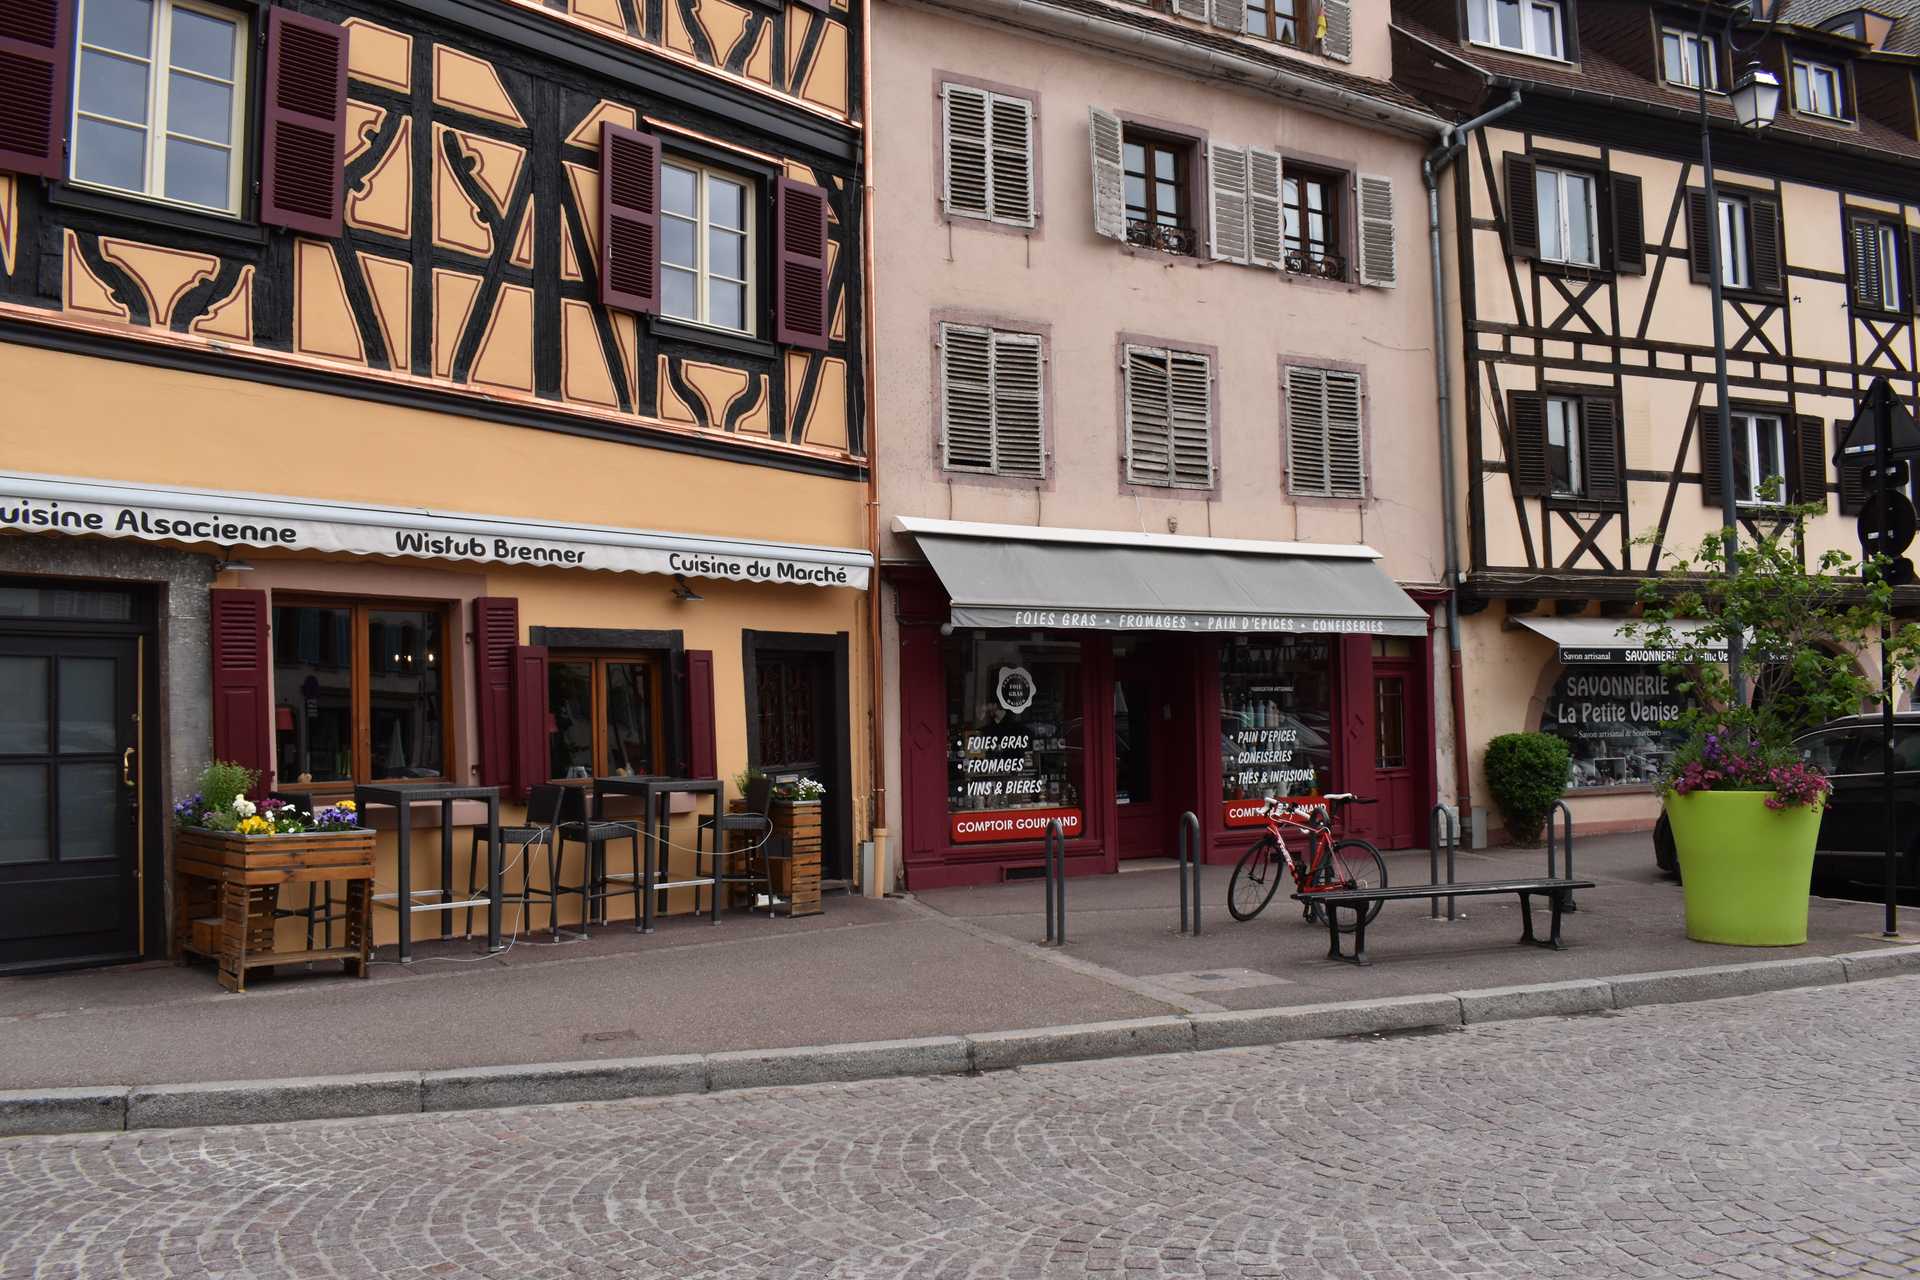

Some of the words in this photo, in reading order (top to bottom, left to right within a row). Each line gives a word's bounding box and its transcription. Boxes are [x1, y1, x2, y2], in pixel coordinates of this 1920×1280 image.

[0, 500, 103, 531] uisine
[115, 508, 297, 544] Alsacienne
[395, 531, 487, 557] Wistub
[494, 538, 586, 564] Brenner
[669, 552, 741, 577] Cuisine
[747, 559, 771, 579] du
[777, 561, 847, 584] Marché
[1015, 611, 1055, 626] FOIES
[1062, 613, 1097, 627] GRAS
[1119, 615, 1187, 629] FROMAGES
[1208, 617, 1237, 631] PAIN
[1242, 617, 1294, 631] D'EPICES
[1312, 619, 1384, 633] CONFISERIES
[1563, 650, 1583, 662] Savon
[1584, 650, 1611, 661] artisanal
[1625, 650, 1678, 662] SAVONNERI
[1567, 675, 1670, 697] SAVONNERIE
[1558, 704, 1577, 724] La
[1582, 702, 1626, 723] Petite
[1630, 700, 1679, 722] Venise
[967, 736, 998, 750] FOIES
[1001, 735, 1029, 750] GRAS
[1238, 731, 1258, 744] PAIN
[1260, 730, 1297, 743] D'EPICES
[1238, 750, 1292, 764] CONFISERIES
[967, 758, 1024, 773] FROMAGES
[1261, 771, 1269, 783] &
[1270, 769, 1315, 783] INFUSIONS
[967, 781, 992, 796] VINS
[994, 781, 1003, 795] &
[1006, 780, 1042, 794] BIERES
[957, 819, 1013, 833] COMPTOIR
